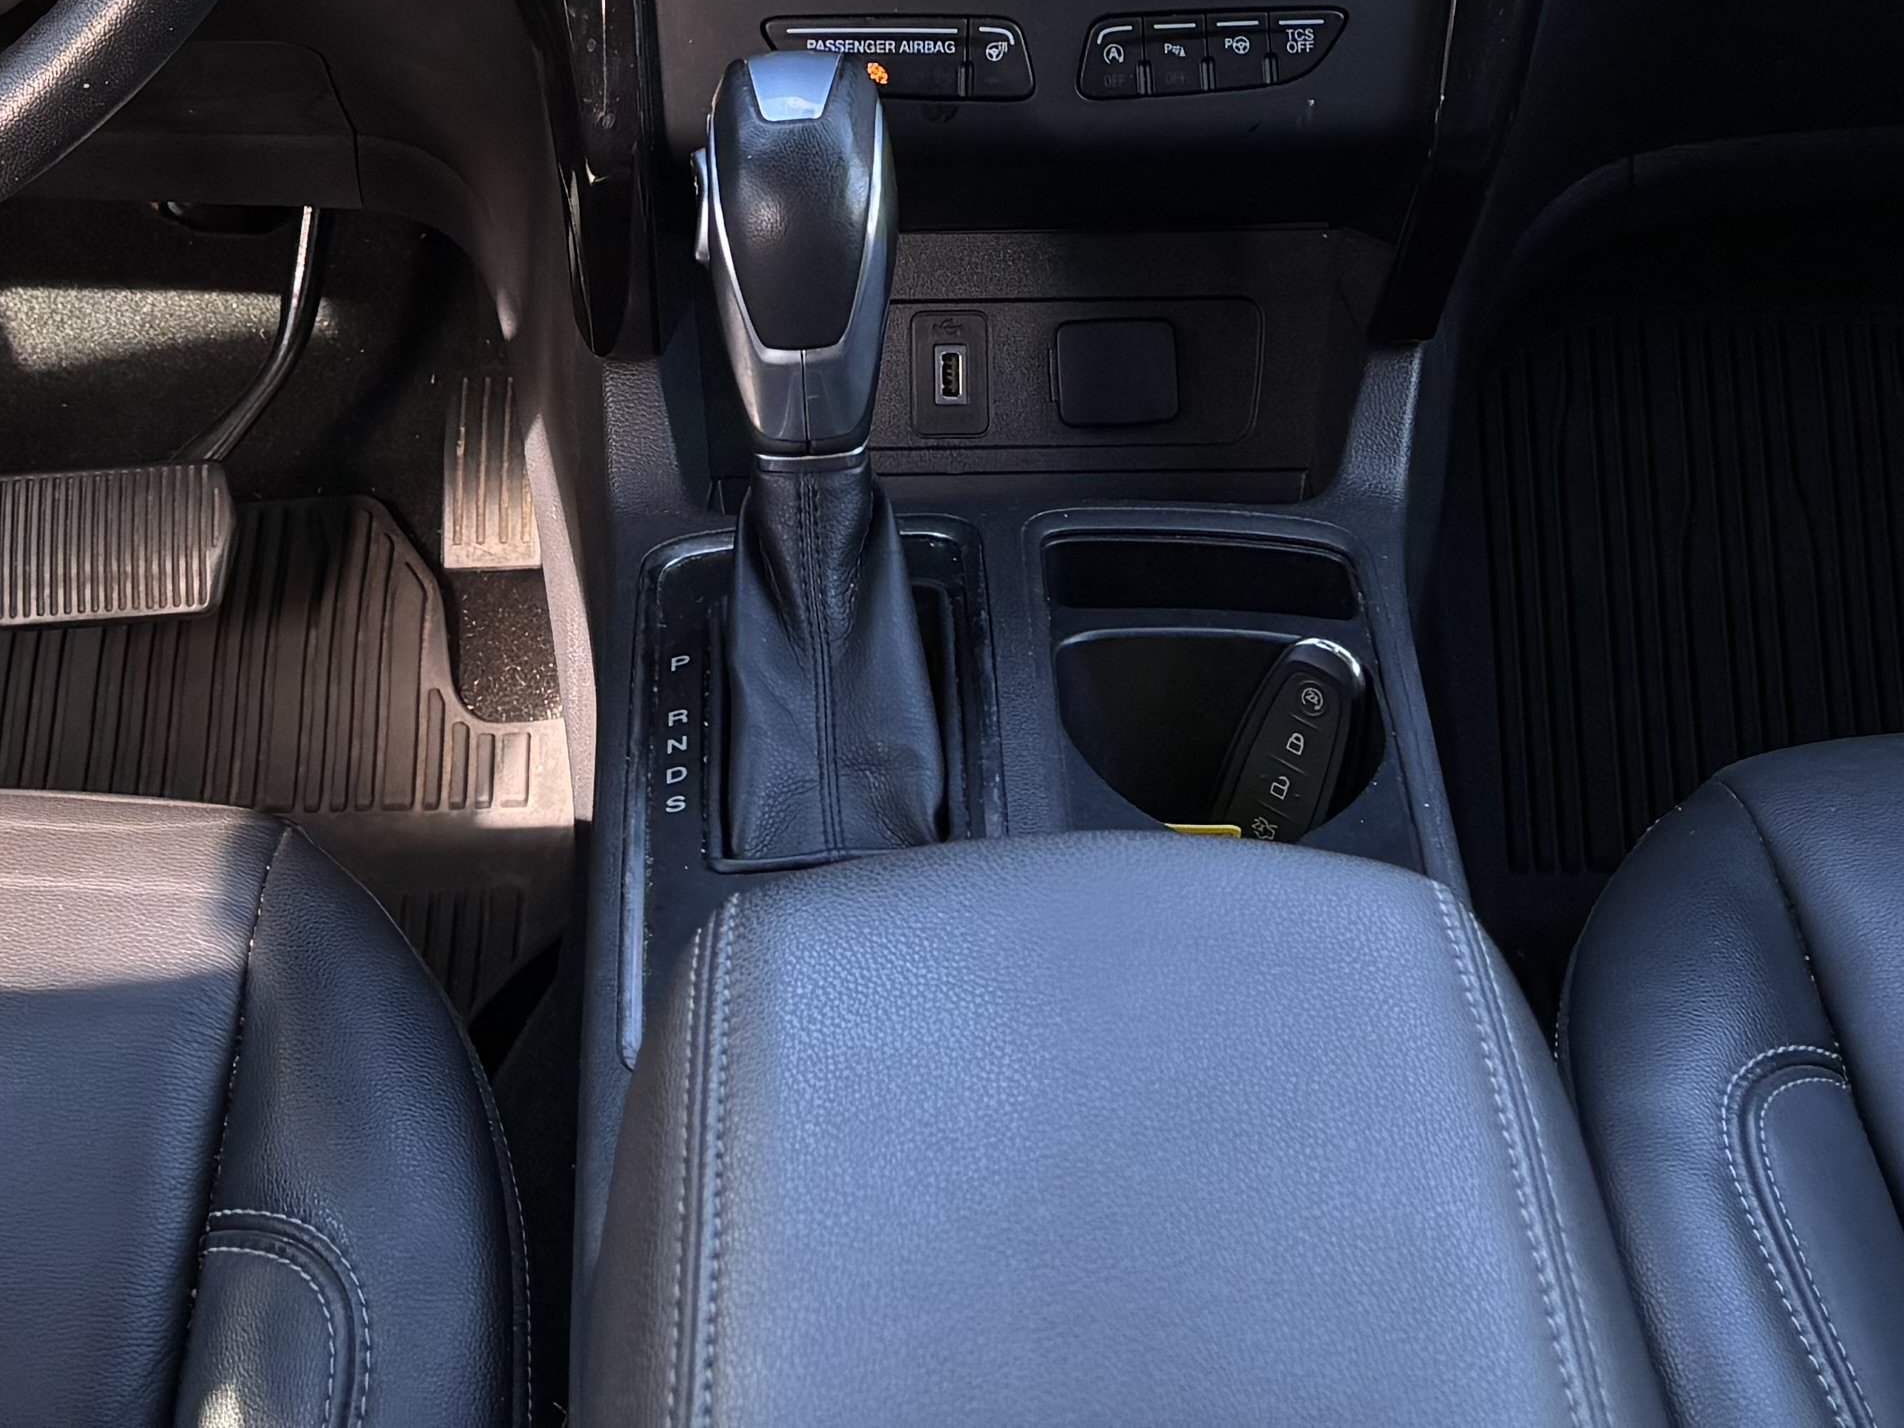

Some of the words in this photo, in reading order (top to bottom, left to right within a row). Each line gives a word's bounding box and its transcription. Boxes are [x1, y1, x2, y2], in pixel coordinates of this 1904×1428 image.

[1286, 28, 1314, 41] TCS
[807, 40, 896, 53] PASSENGER
[899, 39, 956, 53] AIRBAG
[1286, 41, 1314, 54] OFF
[671, 655, 691, 672] P
[668, 709, 688, 727] R
[667, 735, 688, 754] N
[666, 766, 688, 784] D
[665, 795, 686, 813] S
